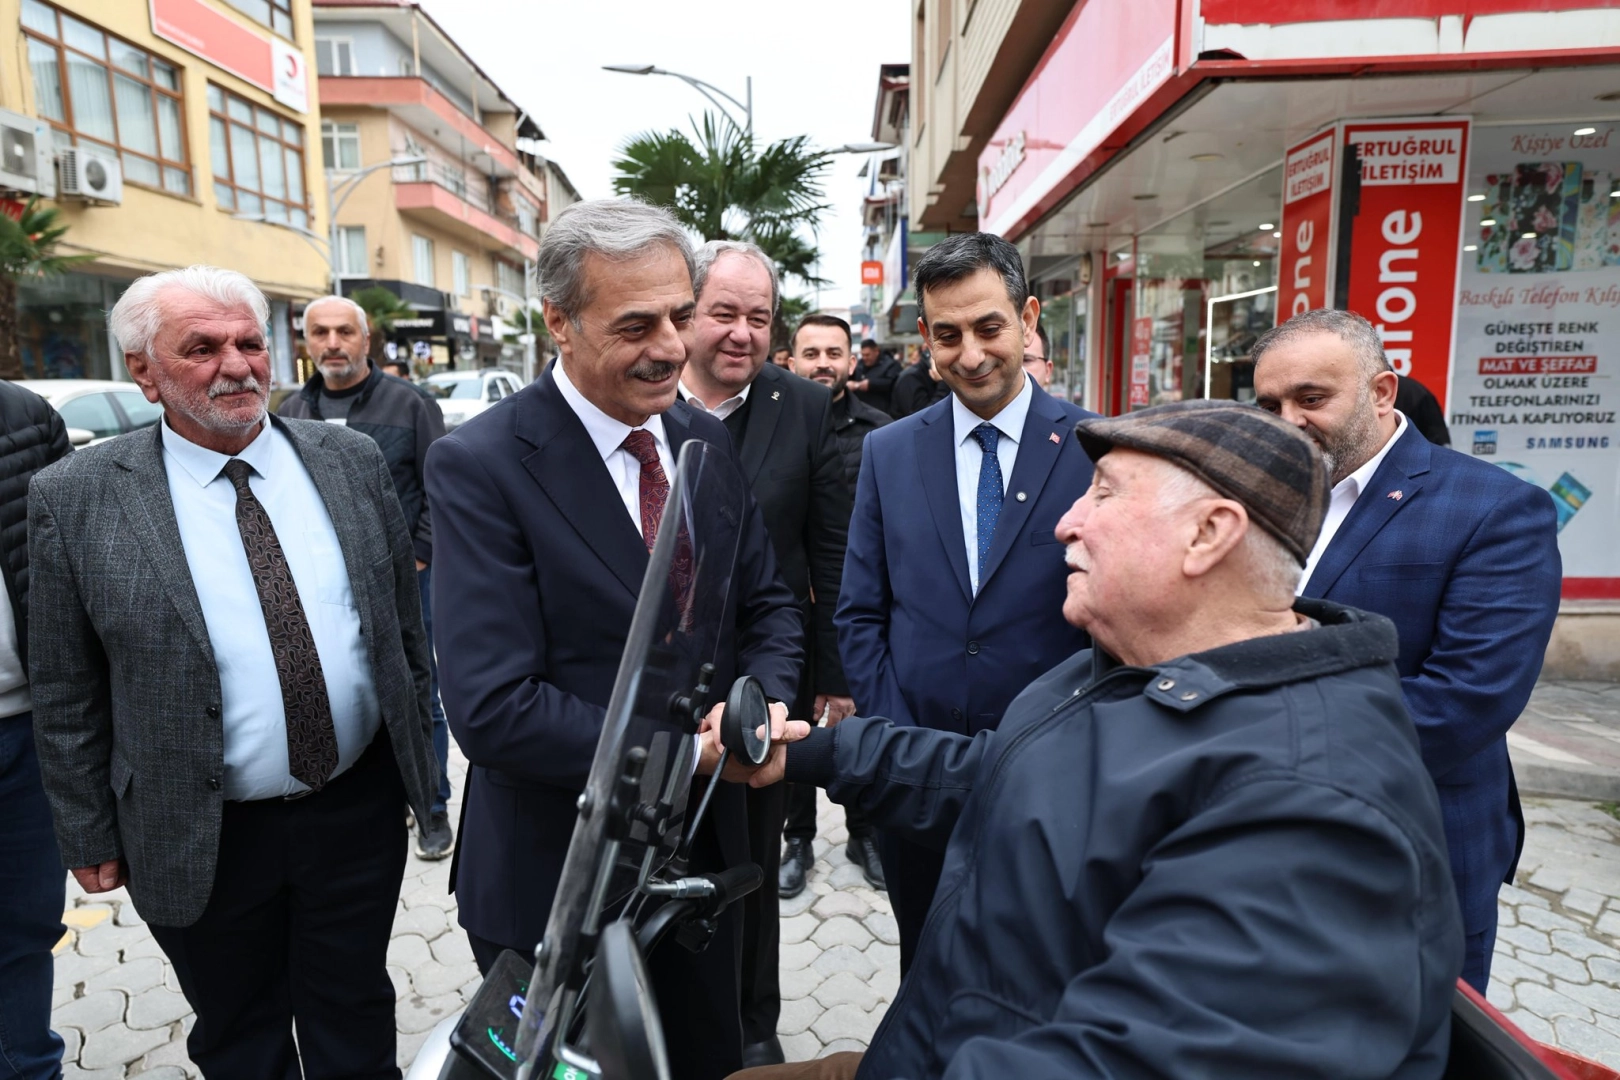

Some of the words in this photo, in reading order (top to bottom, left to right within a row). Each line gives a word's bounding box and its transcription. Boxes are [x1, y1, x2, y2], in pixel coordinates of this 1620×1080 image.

[1356, 136, 1456, 157] ERTUĞRUL
[1511, 132, 1564, 155] Kişiye
[1362, 159, 1443, 184] İLETİŞİM
[1519, 285, 1579, 309] Telefon
[1484, 320, 1553, 339] GÜNEŞTE
[1558, 321, 1599, 334] RENK
[1495, 337, 1584, 356] DEĞİŞTİREN
[1483, 359, 1515, 371] MAT
[1518, 359, 1538, 371] VE
[1541, 358, 1594, 374] ŞEFFAF
[1483, 377, 1537, 390] OLMAK
[1541, 374, 1590, 389] ÜZERE
[1469, 394, 1601, 408] TELEFONLARINIZI
[1523, 411, 1616, 425] KAPLIYORUZ
[1526, 436, 1610, 449] SAMSUNG
